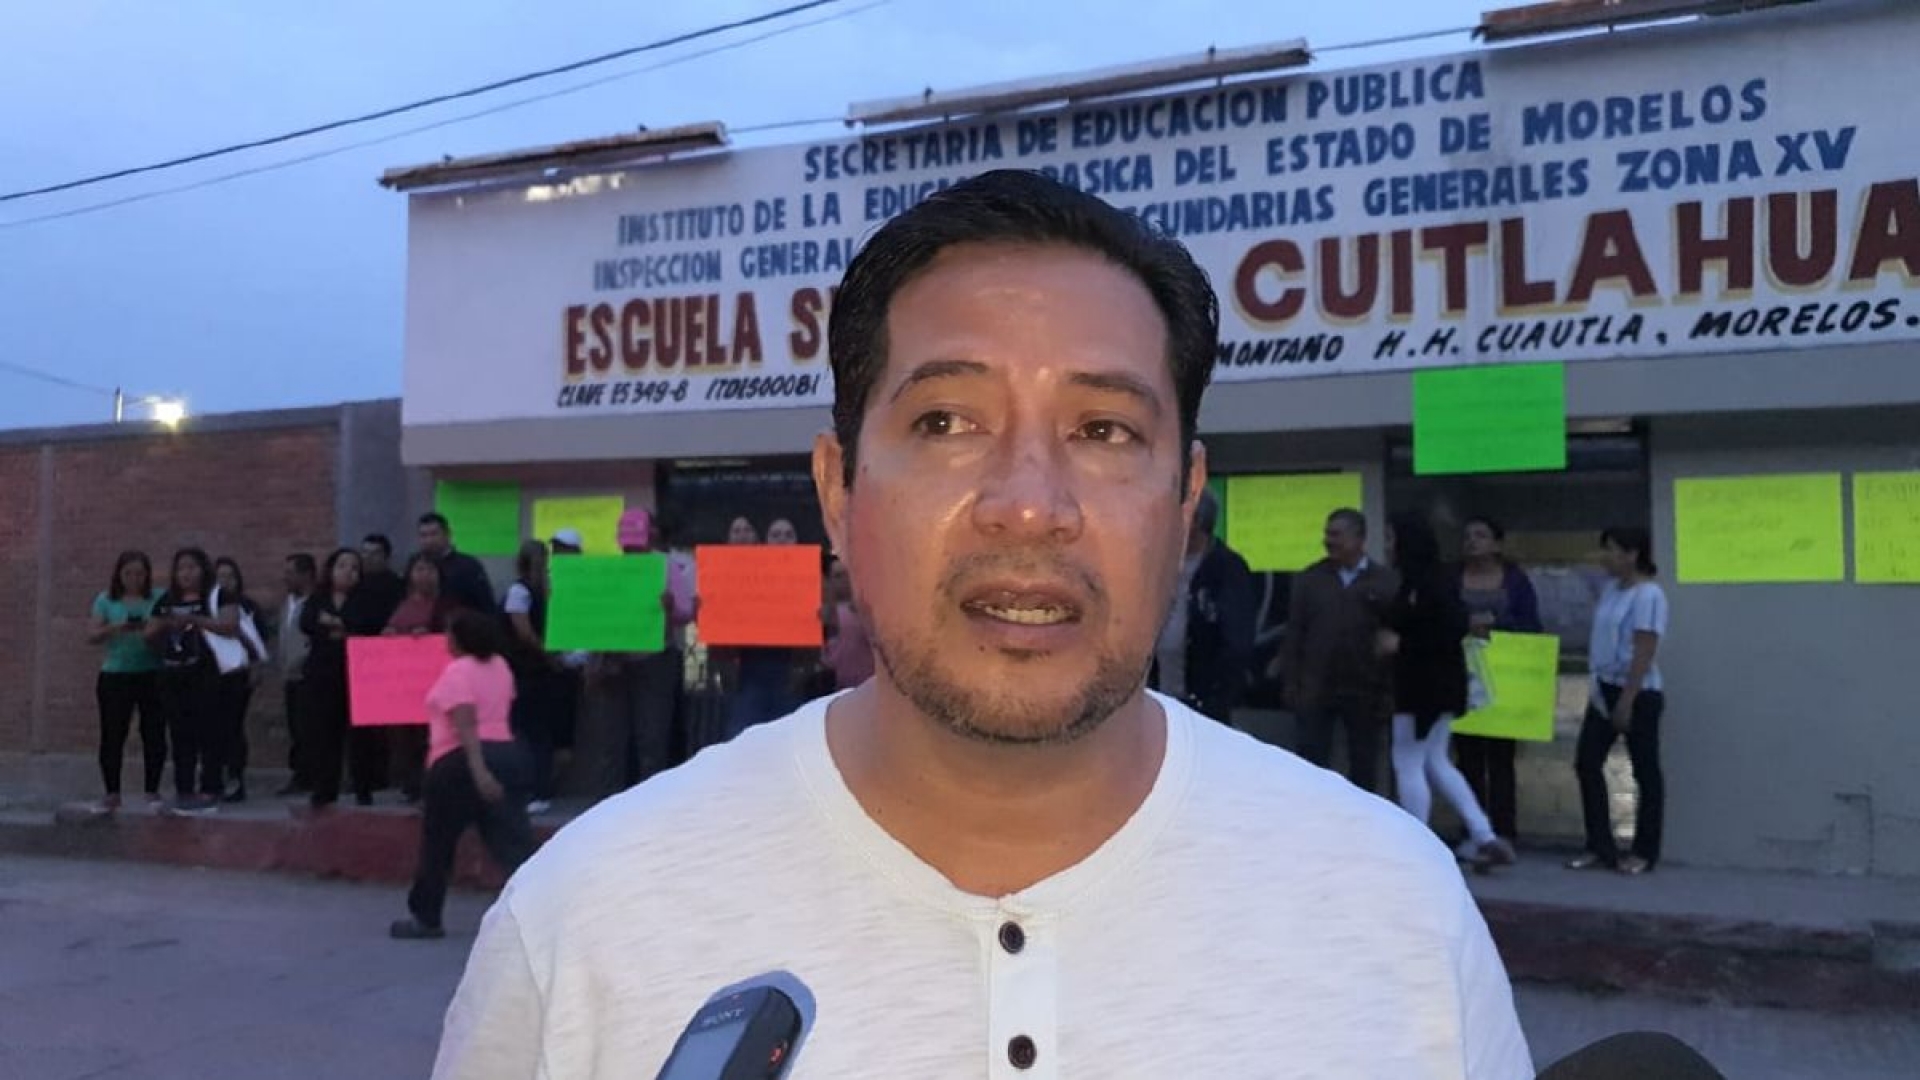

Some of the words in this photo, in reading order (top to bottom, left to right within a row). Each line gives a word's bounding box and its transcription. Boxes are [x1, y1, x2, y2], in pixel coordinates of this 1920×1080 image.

[618, 204, 743, 246] INSTITUTO
[753, 197, 787, 233] DE
[802, 191, 841, 228] LA
[864, 176, 976, 221] EDUC
[1175, 145, 1236, 186] DEL
[1266, 121, 1415, 177] ESTADO
[1440, 113, 1491, 152] DE
[1523, 78, 1768, 147] MORELOS
[804, 123, 1003, 182] SECRETARIA
[1016, 117, 1058, 156] DE
[1072, 85, 1289, 148] EDUCACION
[1305, 60, 1484, 119] PUBLICA
[593, 249, 722, 292] INSPECCION
[1120, 185, 1334, 238] CUNDARIAS
[1363, 159, 1589, 218] GENERALES
[1617, 141, 1761, 192] ZONA
[1775, 126, 1857, 176] XV
[563, 290, 764, 379] ESCUELA
[789, 286, 840, 360] S
[1690, 298, 1919, 339] MORELOS.
